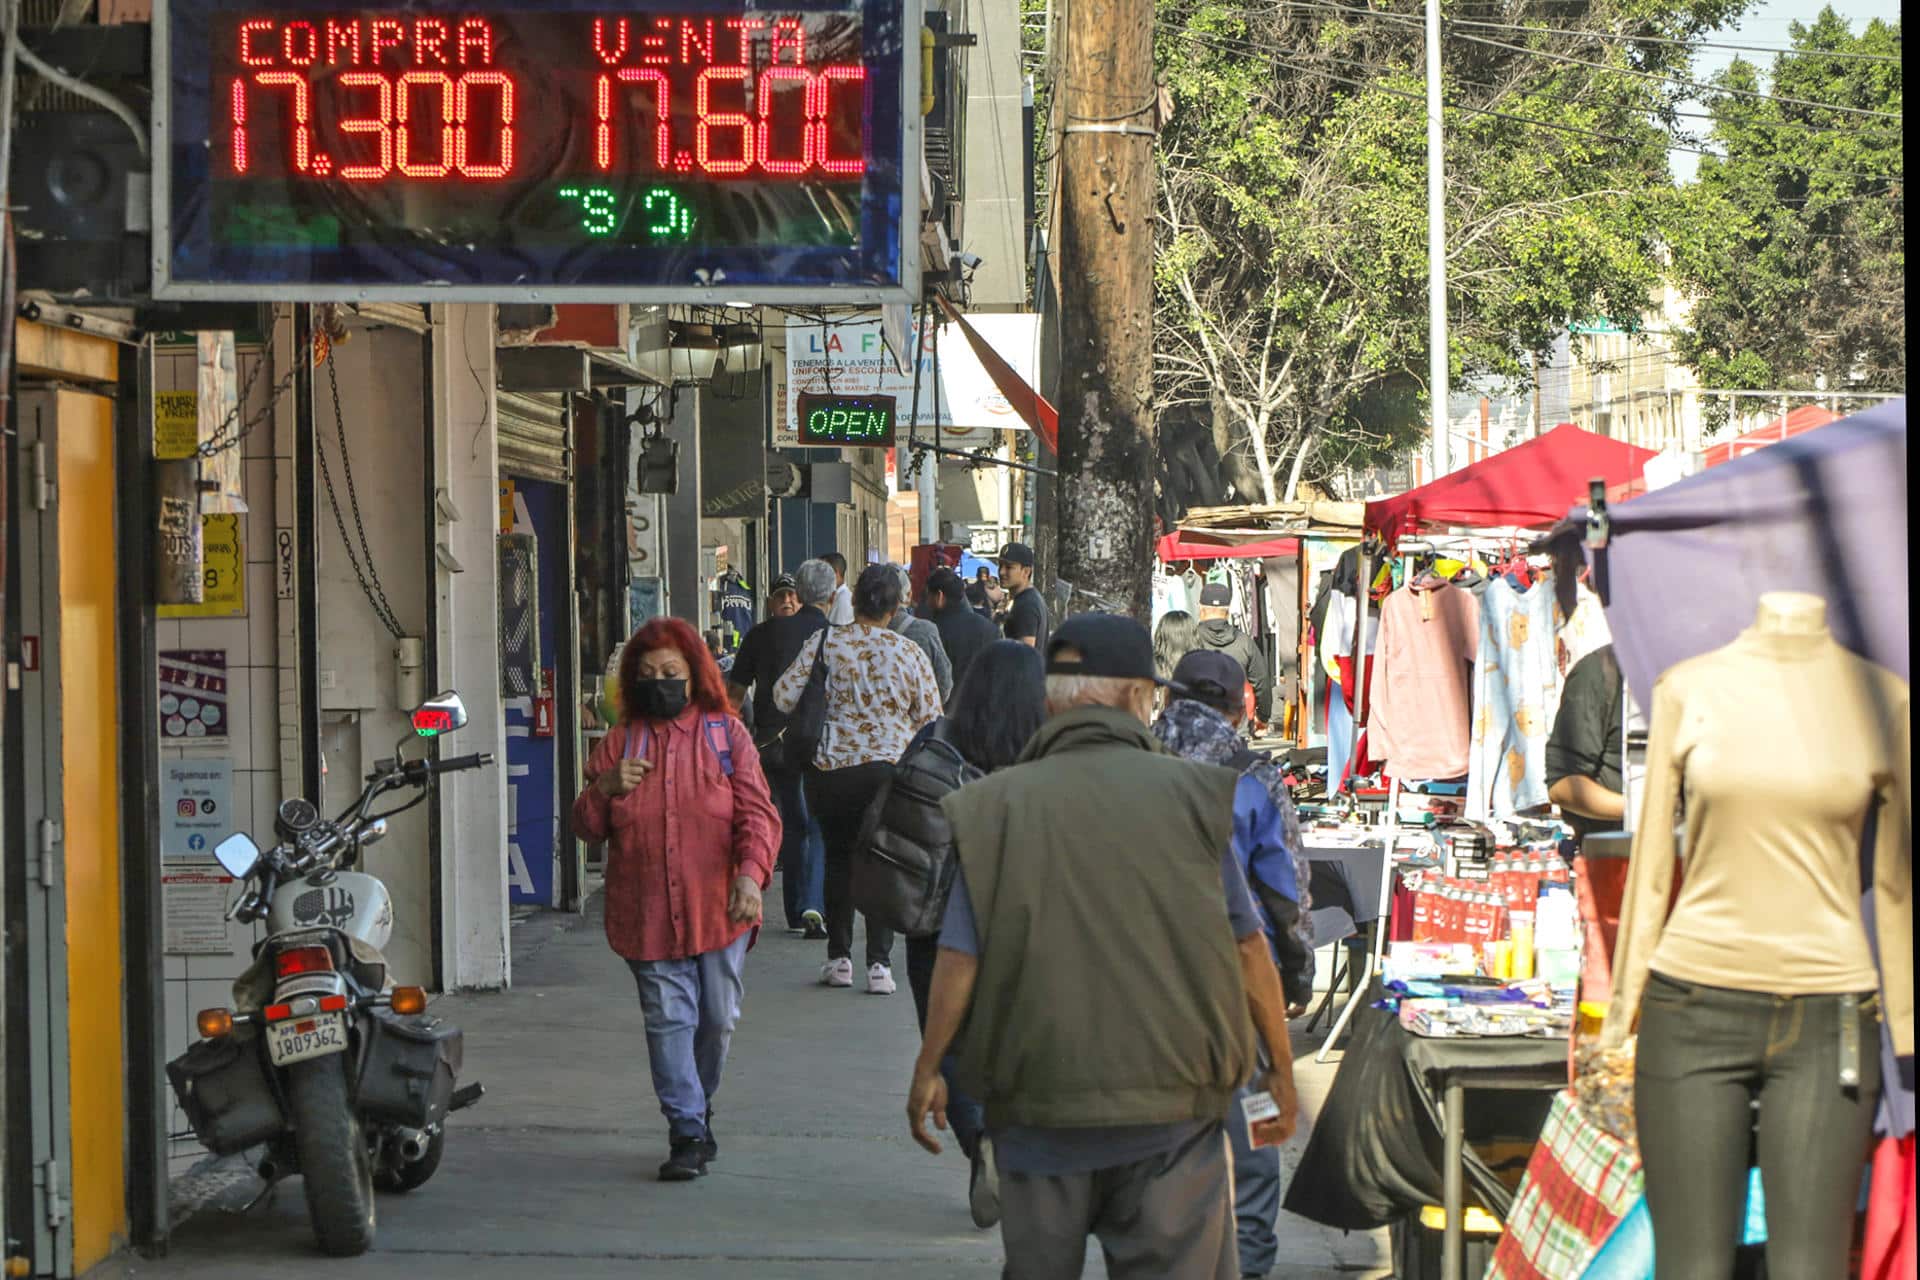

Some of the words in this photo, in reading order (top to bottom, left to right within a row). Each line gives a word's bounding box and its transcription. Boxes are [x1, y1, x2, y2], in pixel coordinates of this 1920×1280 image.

[241, 19, 492, 65] COMPRA
[593, 18, 806, 65] VENTA
[231, 71, 513, 178] 17.300
[810, 333, 843, 353] LA
[849, 367, 899, 376] ESCOLARE
[809, 409, 887, 436] OPEN
